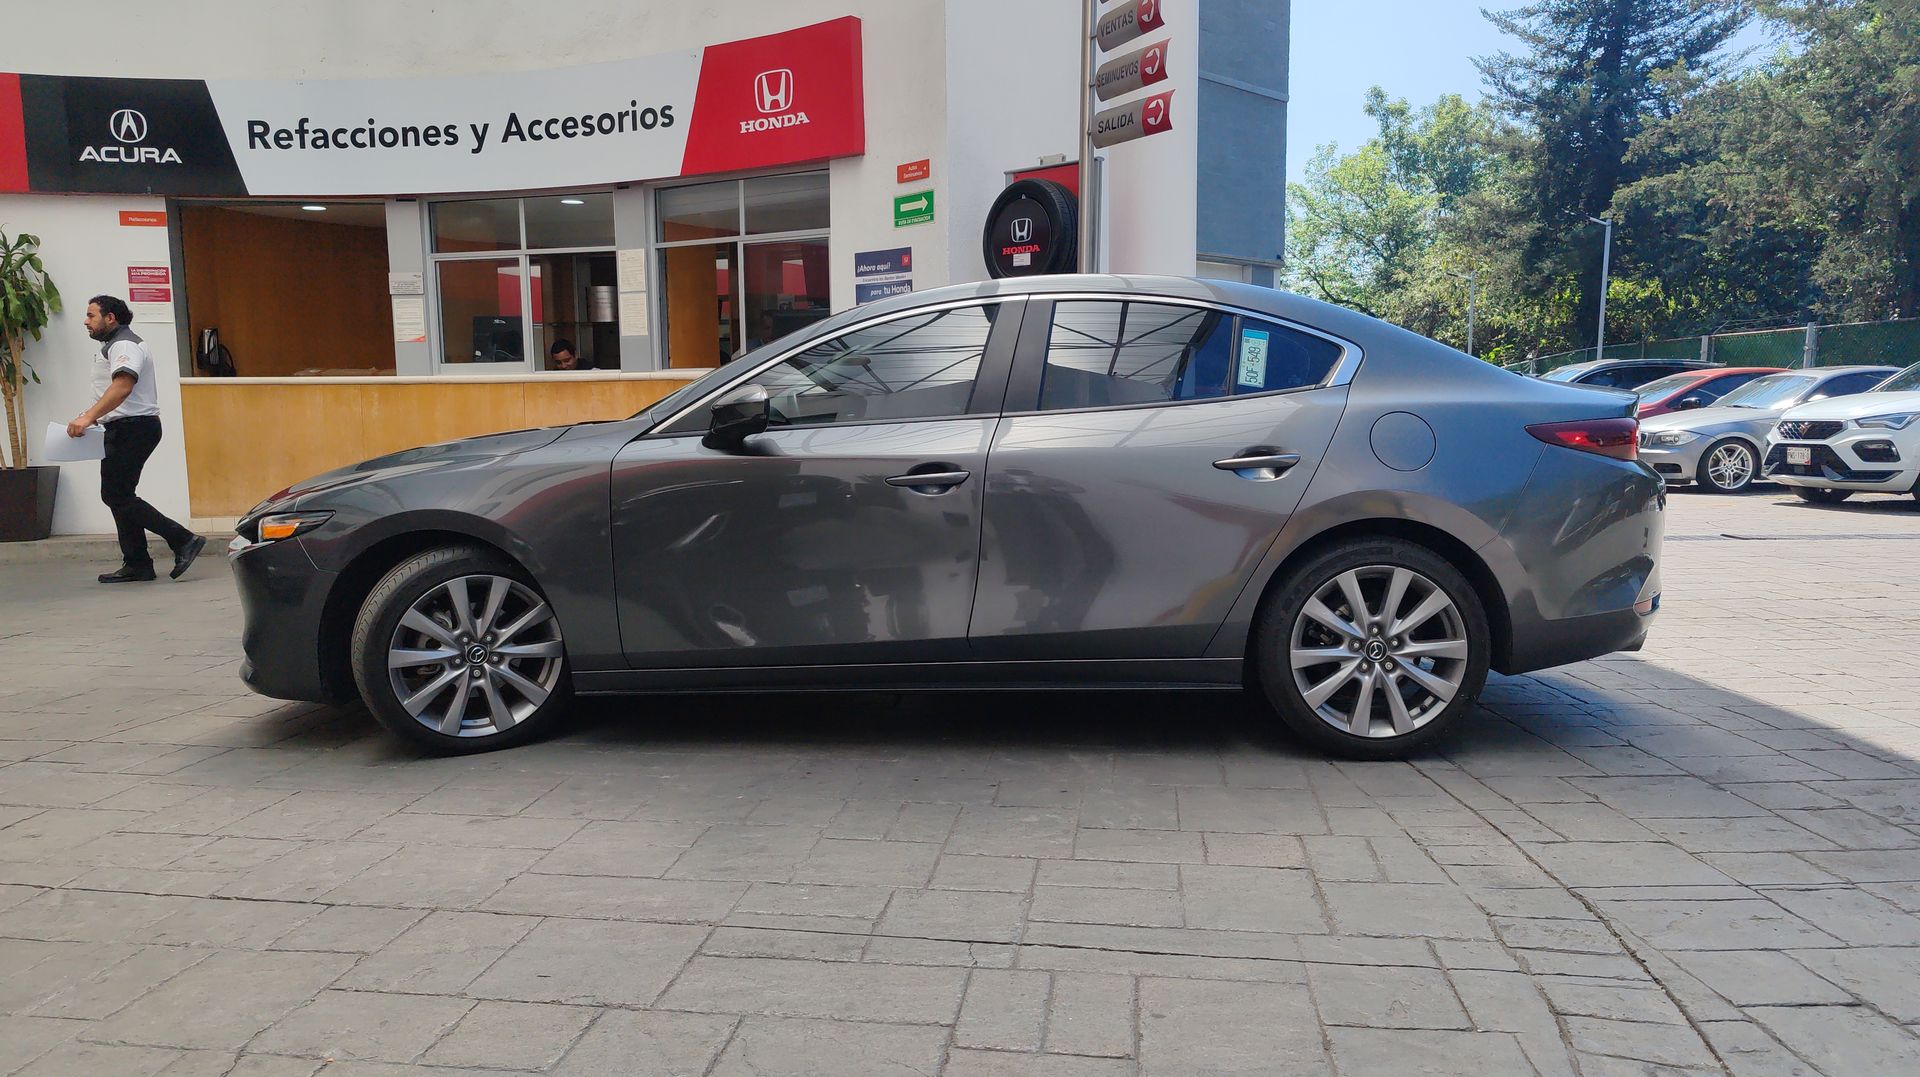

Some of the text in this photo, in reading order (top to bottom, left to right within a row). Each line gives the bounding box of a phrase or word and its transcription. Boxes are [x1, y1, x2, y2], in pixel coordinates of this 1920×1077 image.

[1100, 10, 1134, 38] VENTAS
[1096, 60, 1139, 88] SEMINUEVOS
[247, 99, 675, 154] Refacciones y Accesorios
[739, 111, 810, 134] HONDA
[1097, 112, 1134, 134] SALIDA
[79, 146, 183, 164] ACURA
[1002, 244, 1041, 256] HONDA
[883, 286, 890, 294] tu
[891, 283, 911, 294] Honda
